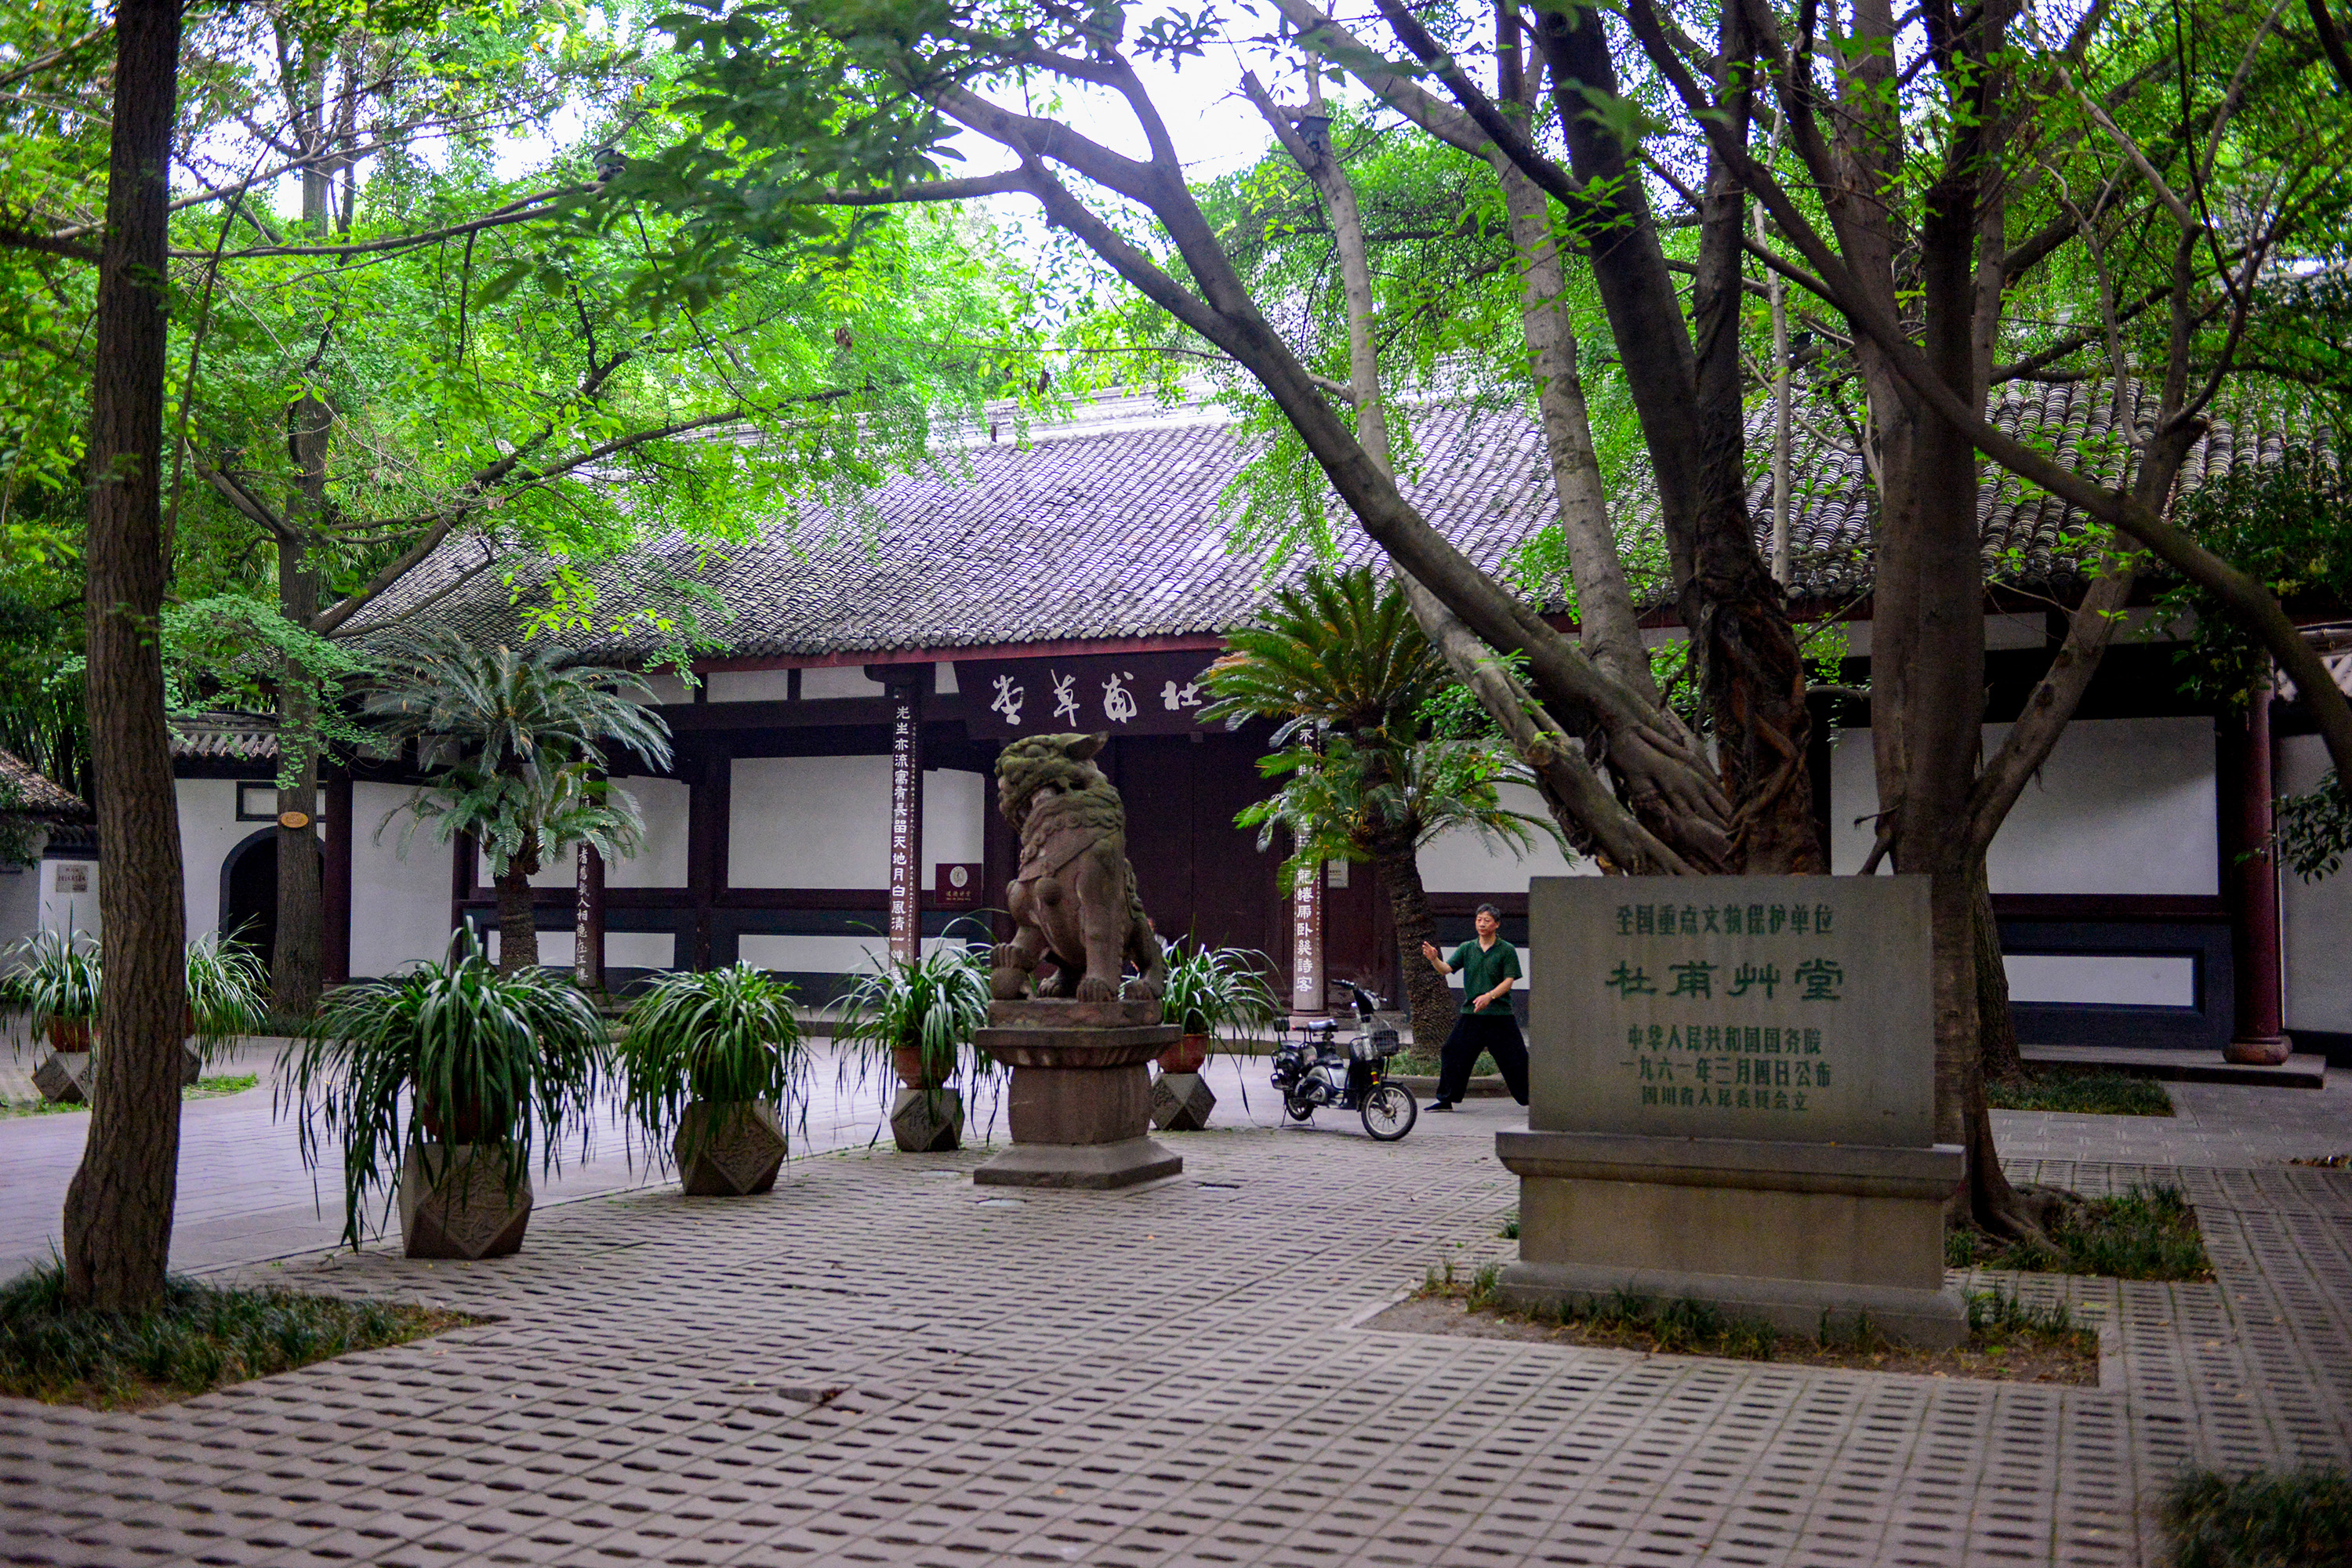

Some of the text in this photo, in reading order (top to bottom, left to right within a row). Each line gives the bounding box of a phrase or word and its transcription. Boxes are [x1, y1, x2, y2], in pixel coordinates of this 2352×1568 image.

[991, 669, 1203, 726] 杜甫草堂
[1617, 904, 1834, 935] 全国重点文物保护单位
[1627, 1023, 1821, 1054] 中华人民共和国国务院
[1619, 1054, 1831, 1087] 一九六一年三月四日公布
